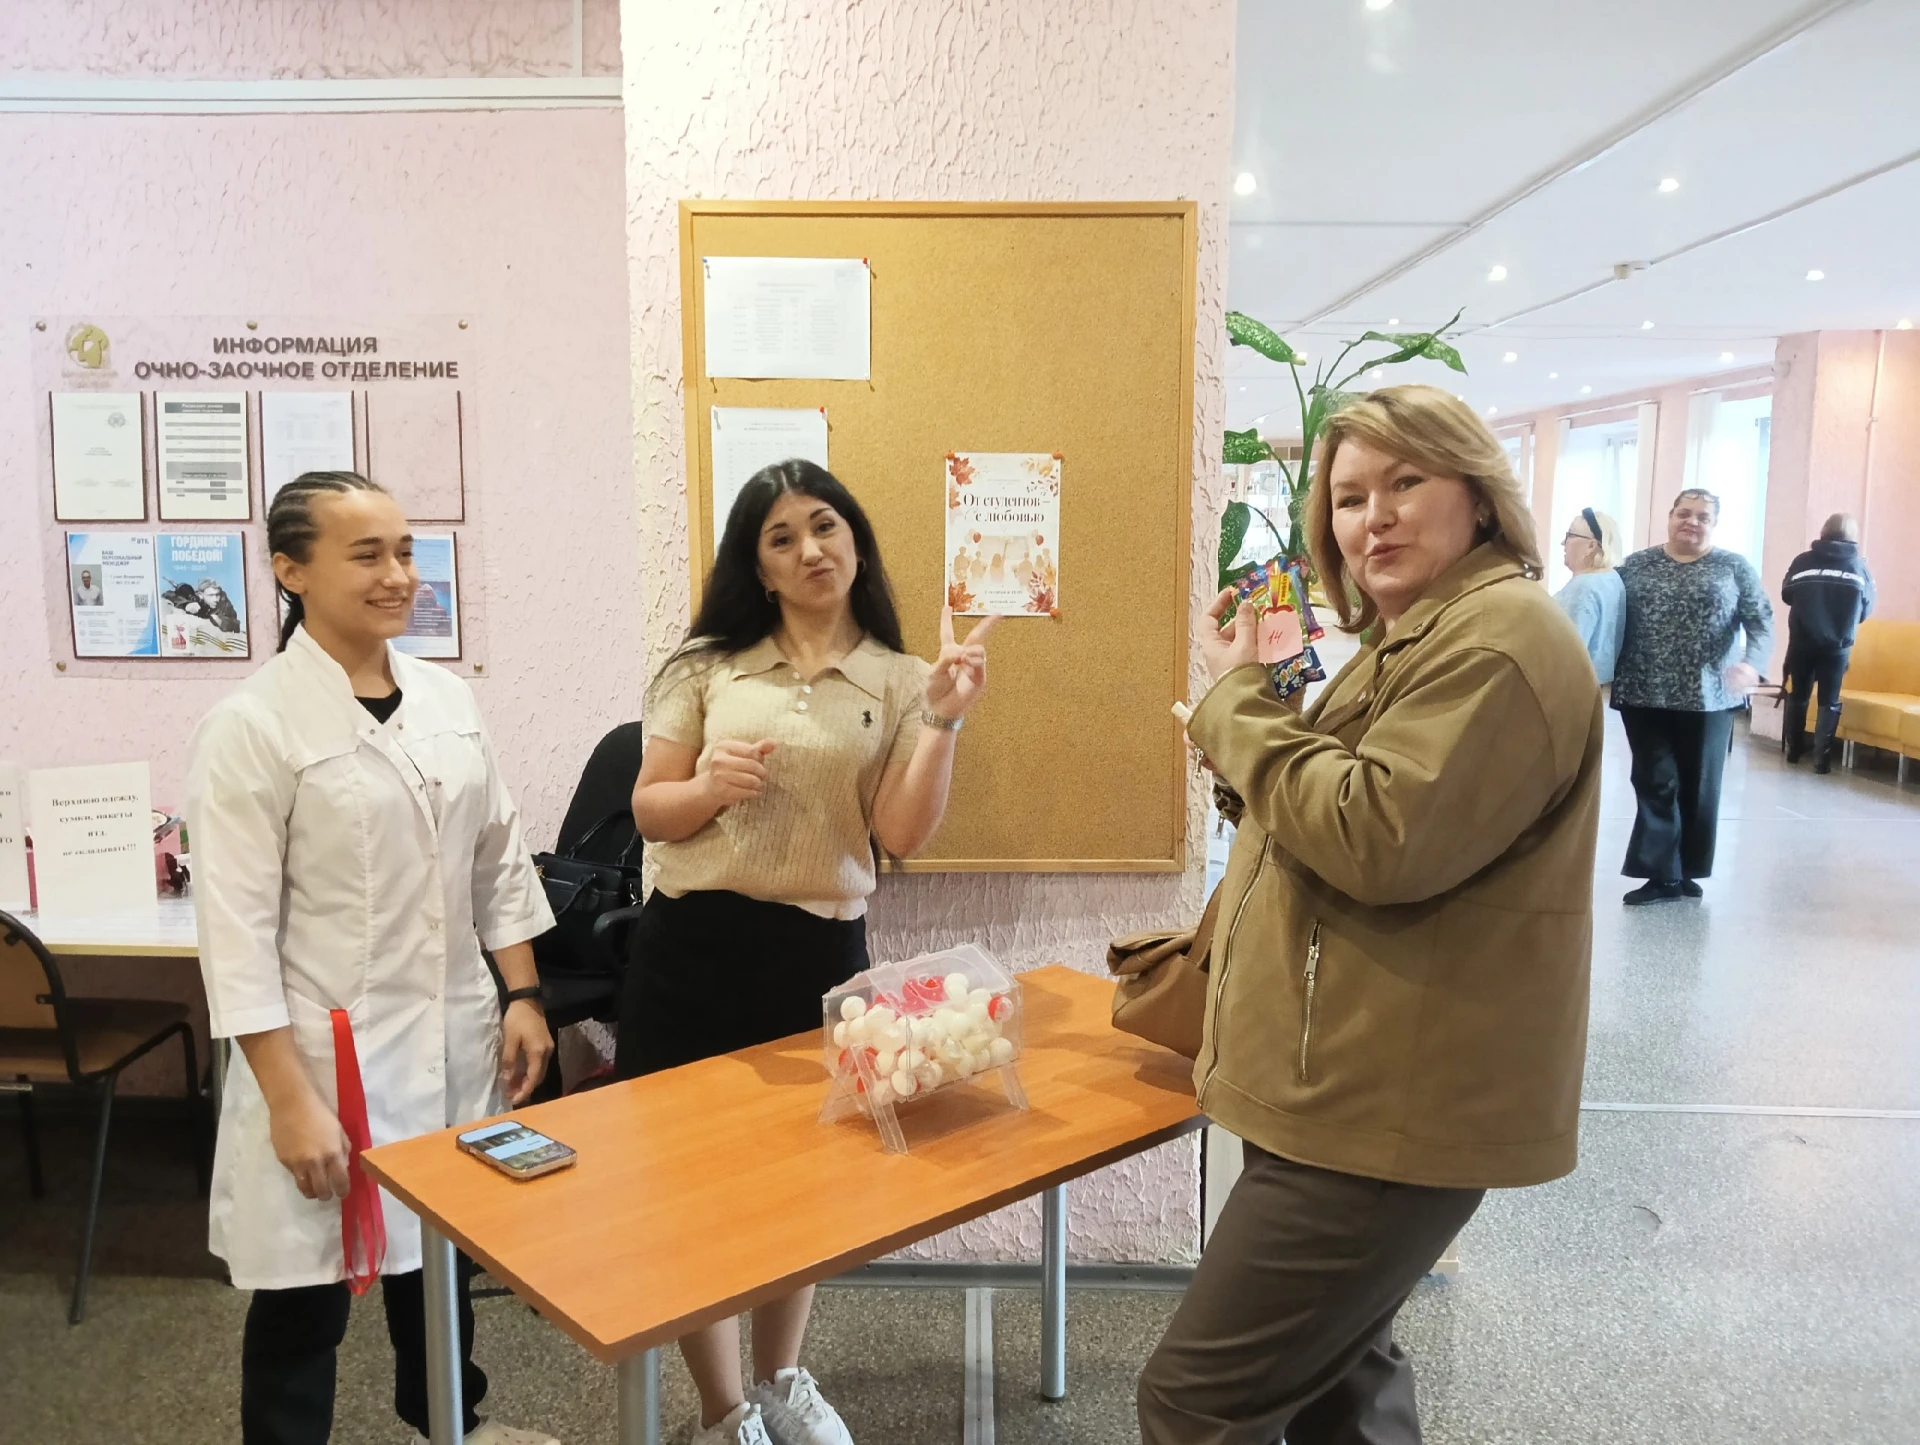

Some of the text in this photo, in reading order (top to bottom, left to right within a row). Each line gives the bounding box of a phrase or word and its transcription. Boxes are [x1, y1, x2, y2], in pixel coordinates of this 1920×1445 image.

[213, 337, 378, 356] ИНФОРМАЦИЯ
[134, 361, 315, 379] ОЧНО-ЗАОЧНОЕ
[321, 361, 459, 381] ОТДЕЛЕНИЕ
[963, 493, 980, 507] От
[983, 497, 1040, 509] студентов
[975, 509, 1045, 522] с любовью
[170, 535, 228, 549] ГОРДИМСЯ
[52, 797, 100, 807] Верхнюю
